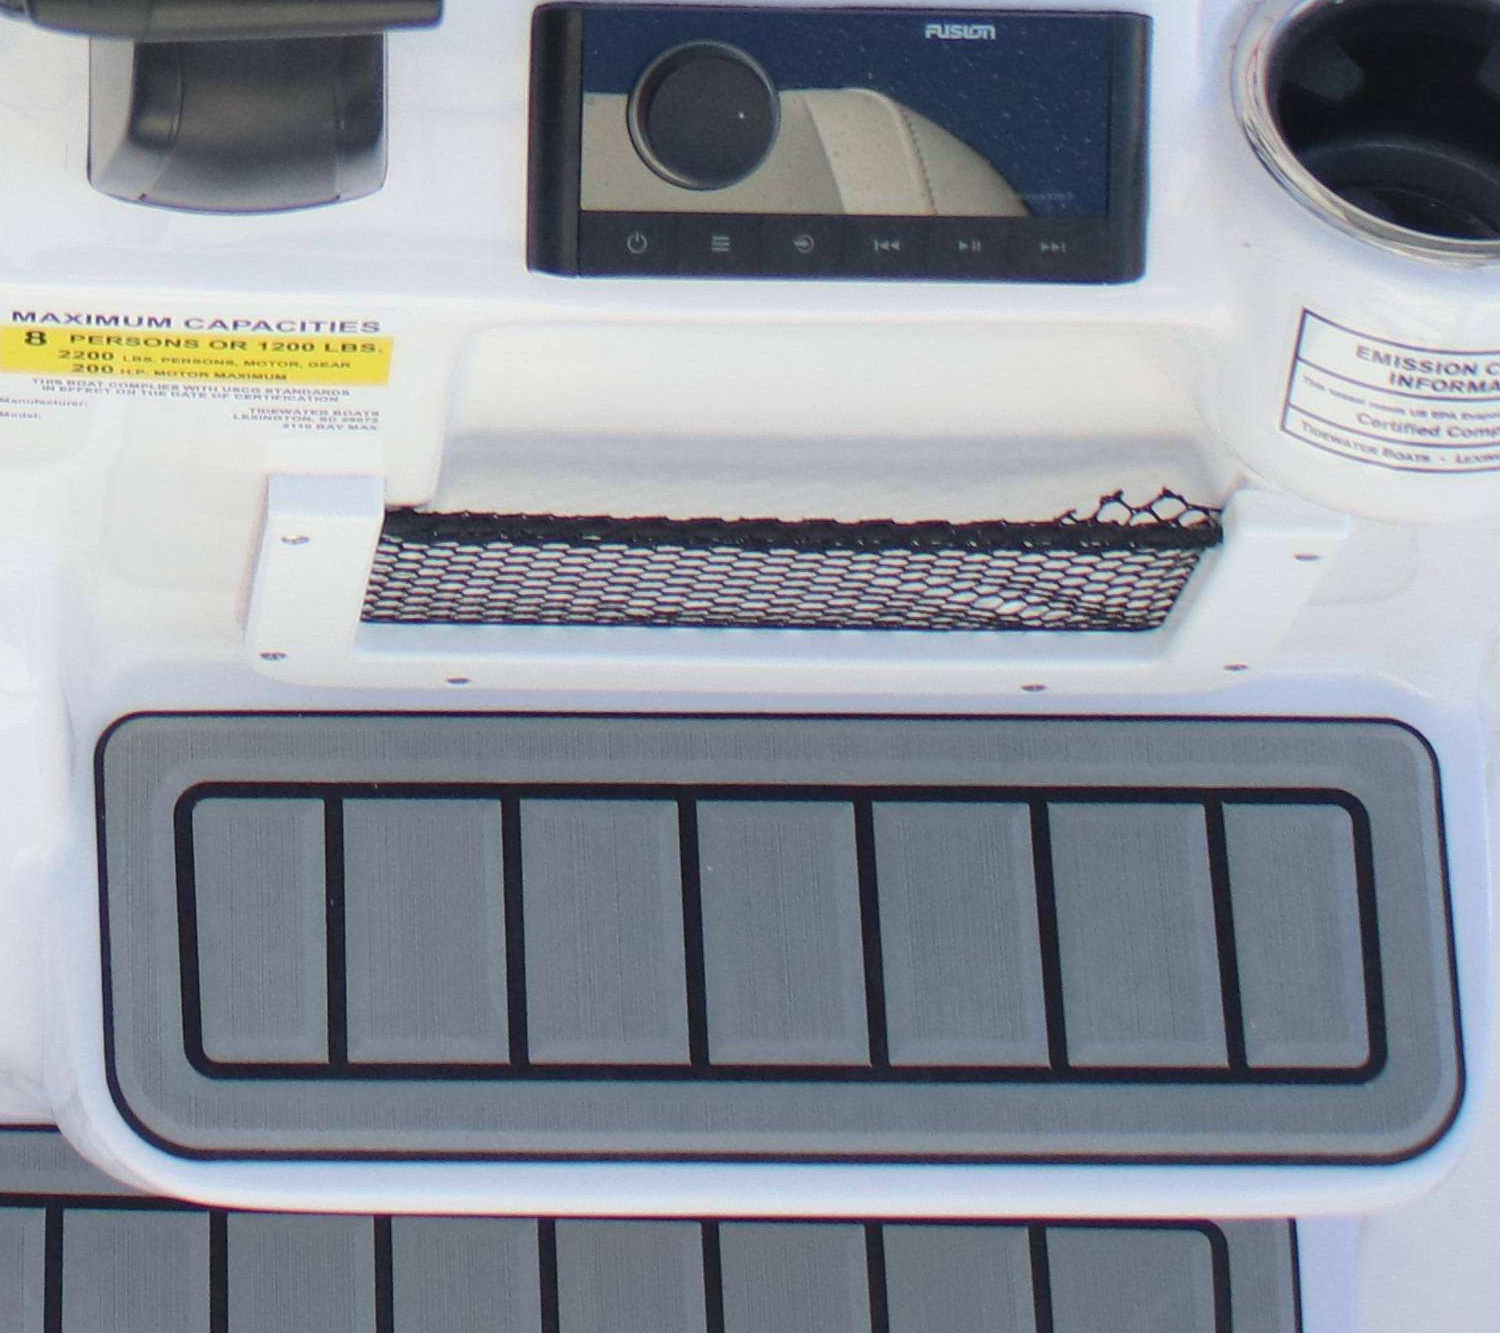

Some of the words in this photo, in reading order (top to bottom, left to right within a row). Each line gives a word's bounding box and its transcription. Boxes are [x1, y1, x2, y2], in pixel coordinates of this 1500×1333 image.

[925, 23, 996, 41] FUSION
[11, 311, 172, 329] MAXIMUM
[183, 317, 381, 333] CAPACITIES
[24, 330, 48, 347] 8
[69, 334, 200, 350] PERSONS
[209, 340, 249, 351] OR
[257, 341, 316, 353] 1200
[324, 342, 384, 354] LBS.
[58, 350, 115, 361] 2200
[121, 356, 156, 364] LBS.
[160, 356, 239, 367] PERSONS,
[243, 360, 304, 369] MOTOR,
[308, 361, 352, 369] GEAR
[1356, 345, 1478, 376] EMISSION
[71, 363, 114, 374] 200
[153, 369, 210, 379] MOTOR
[213, 371, 288, 381] MAXIMUM
[59, 386, 111, 394] EFFECT
[141, 389, 167, 397] THE
[171, 391, 207, 399] DATE
[234, 393, 339, 402] CERTIFICATION
[66, 380, 104, 388] BOAT
[108, 382, 179, 390] COMPLIES
[183, 385, 218, 393] WITH
[222, 386, 261, 394] USCG
[265, 388, 350, 396] STANDARDS
[0, 396, 88, 407] Manufacturer:
[0, 411, 41, 420] Model:
[249, 407, 328, 416] TIDEWATER
[332, 409, 380, 417] BOATS
[1356, 412, 1441, 437] Certified
